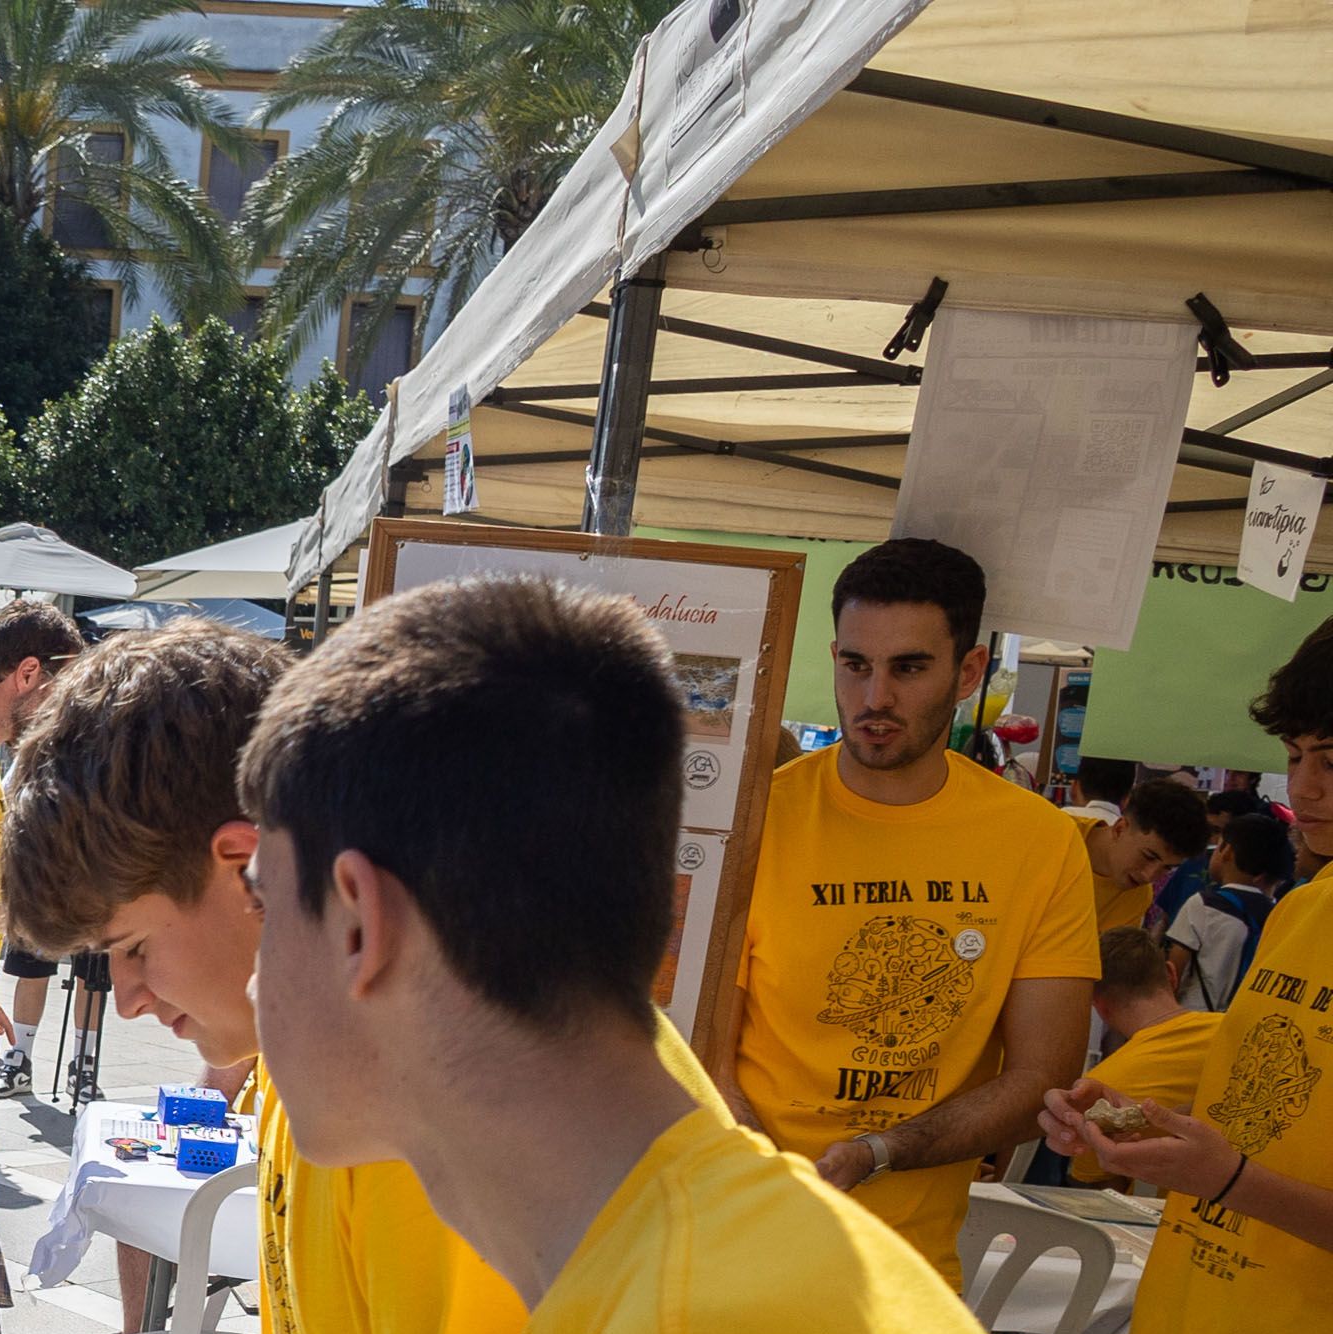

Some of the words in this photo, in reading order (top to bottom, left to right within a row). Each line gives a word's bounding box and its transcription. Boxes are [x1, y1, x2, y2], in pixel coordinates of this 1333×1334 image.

[630, 594, 717, 624] ndalucía
[811, 883, 845, 905] XII
[853, 880, 913, 903] FERIA
[926, 880, 953, 902] DE
[962, 880, 989, 902] LA
[852, 1042, 940, 1067] CIENCIA
